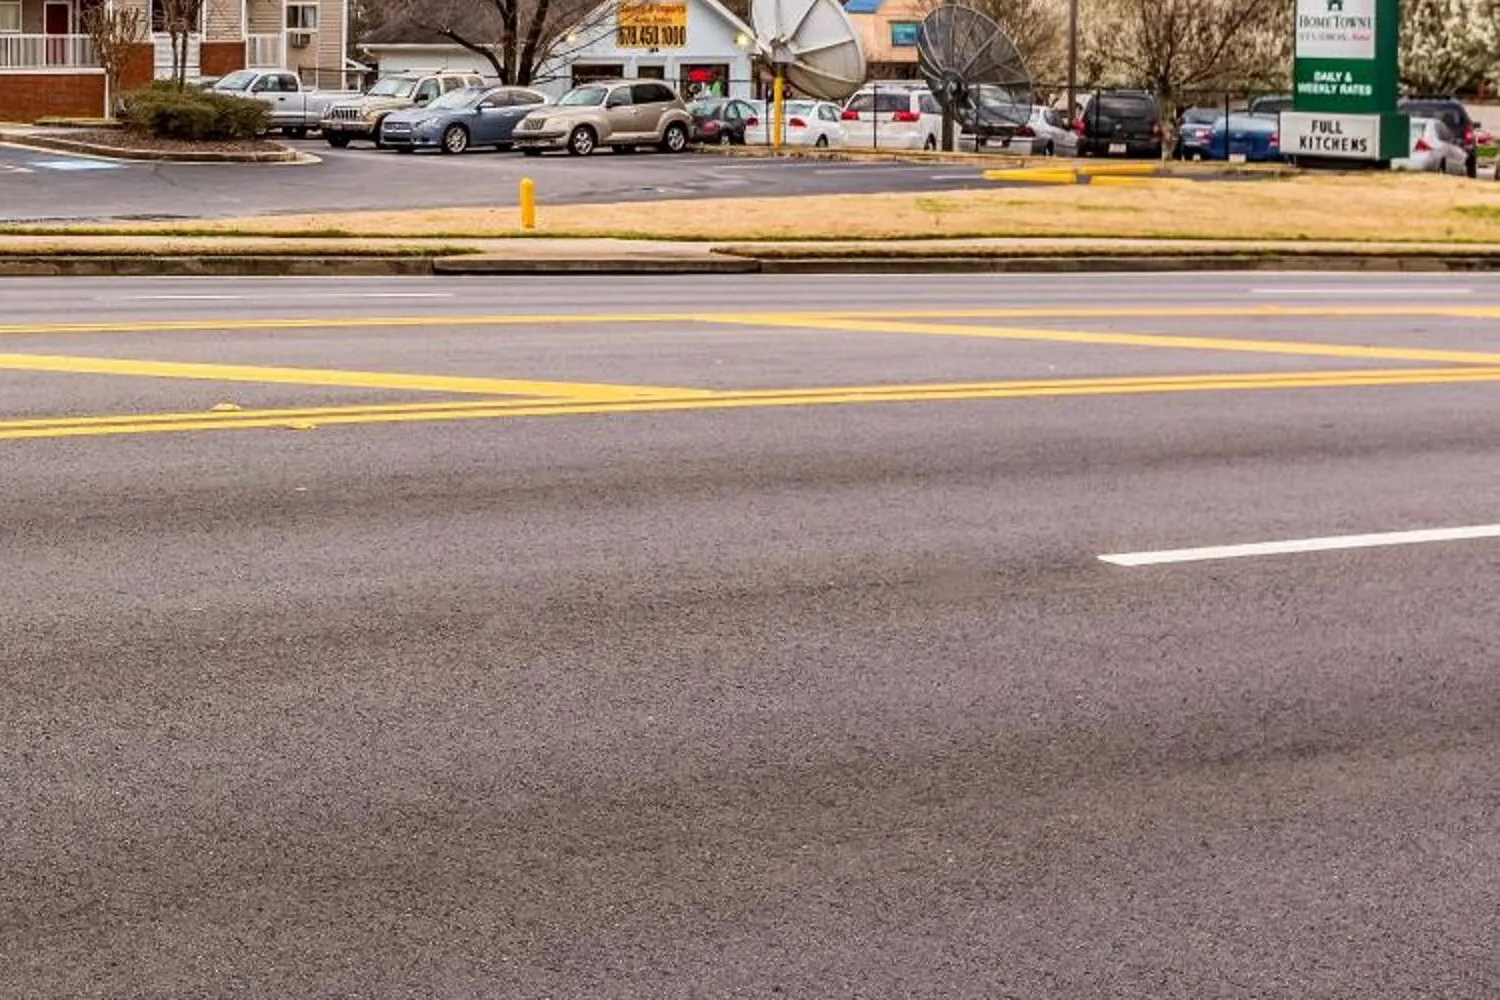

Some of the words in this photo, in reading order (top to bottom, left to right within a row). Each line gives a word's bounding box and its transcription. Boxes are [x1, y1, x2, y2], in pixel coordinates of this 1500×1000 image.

[1314, 71, 1342, 82] DAILY
[1298, 82, 1338, 95] WEEKLY
[1339, 84, 1372, 96] RATES
[1311, 119, 1342, 134] FULL
[1299, 136, 1367, 152] KITCHENS
